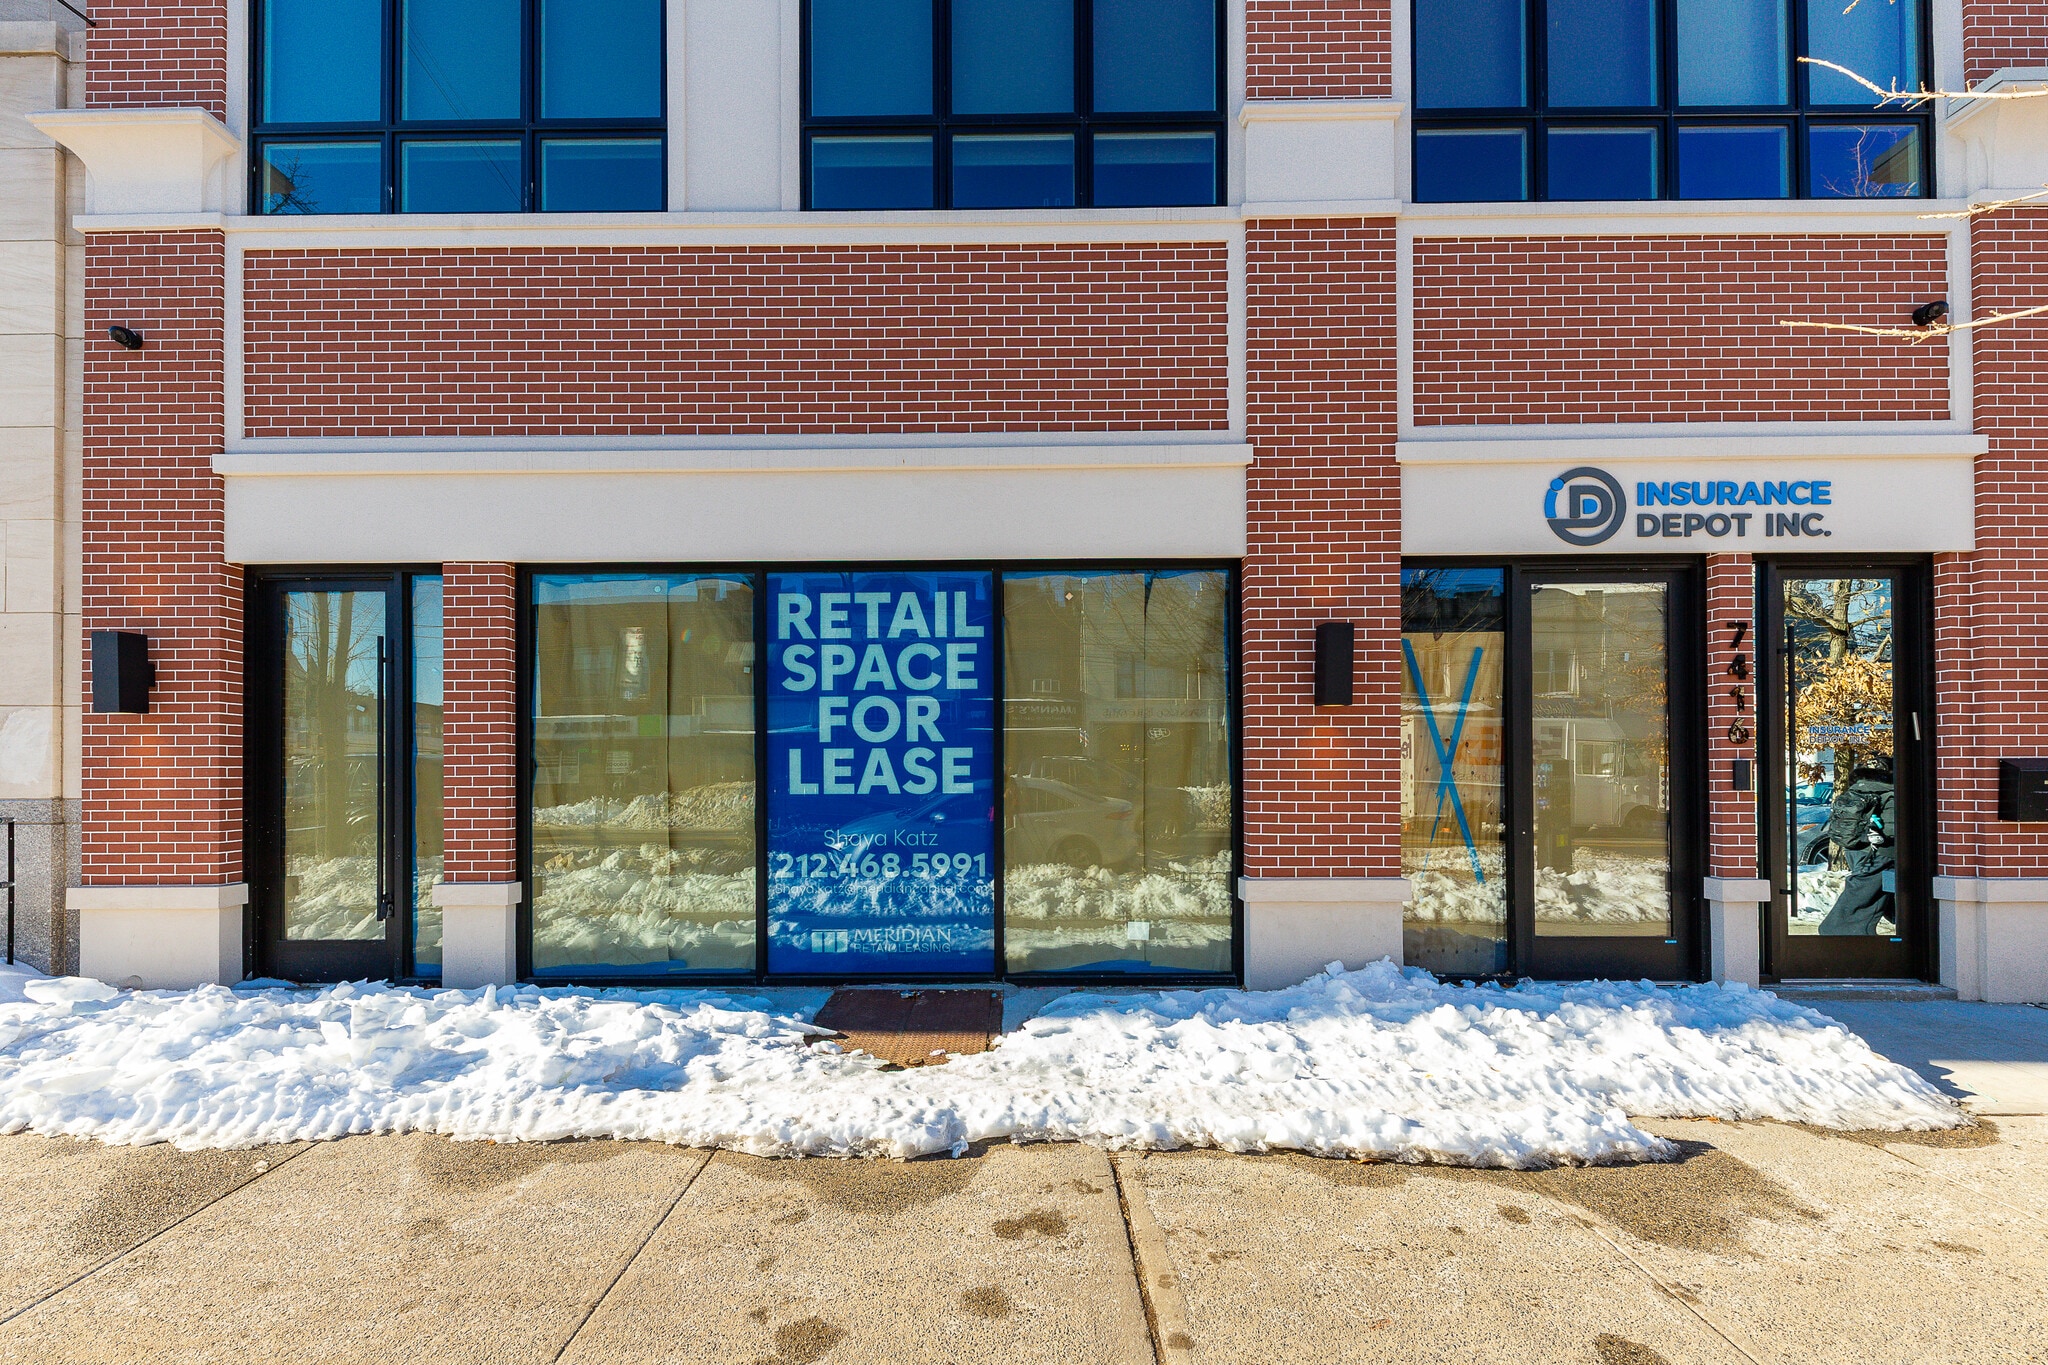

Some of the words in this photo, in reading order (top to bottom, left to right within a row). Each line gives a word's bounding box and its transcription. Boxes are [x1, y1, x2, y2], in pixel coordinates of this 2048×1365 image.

[1636, 480, 1832, 506] INSURANCE
[1636, 512, 1752, 538] DEPOT
[1765, 512, 1832, 537] INC.
[777, 591, 985, 640] RETAIL
[781, 642, 978, 692] SPACE
[1726, 622, 1749, 745] 7416
[818, 695, 945, 743] FOR
[1809, 725, 1871, 734] INSURANCE
[1809, 735, 1845, 745] DEPOT
[788, 746, 974, 795] LEASE
[823, 829, 887, 850] Shaya
[894, 828, 939, 846] Katz
[775, 852, 986, 879] 212.468.5991
[853, 928, 952, 942] MERIDIAN
[853, 942, 897, 953] RETAIL
[899, 942, 952, 953] LEASING
